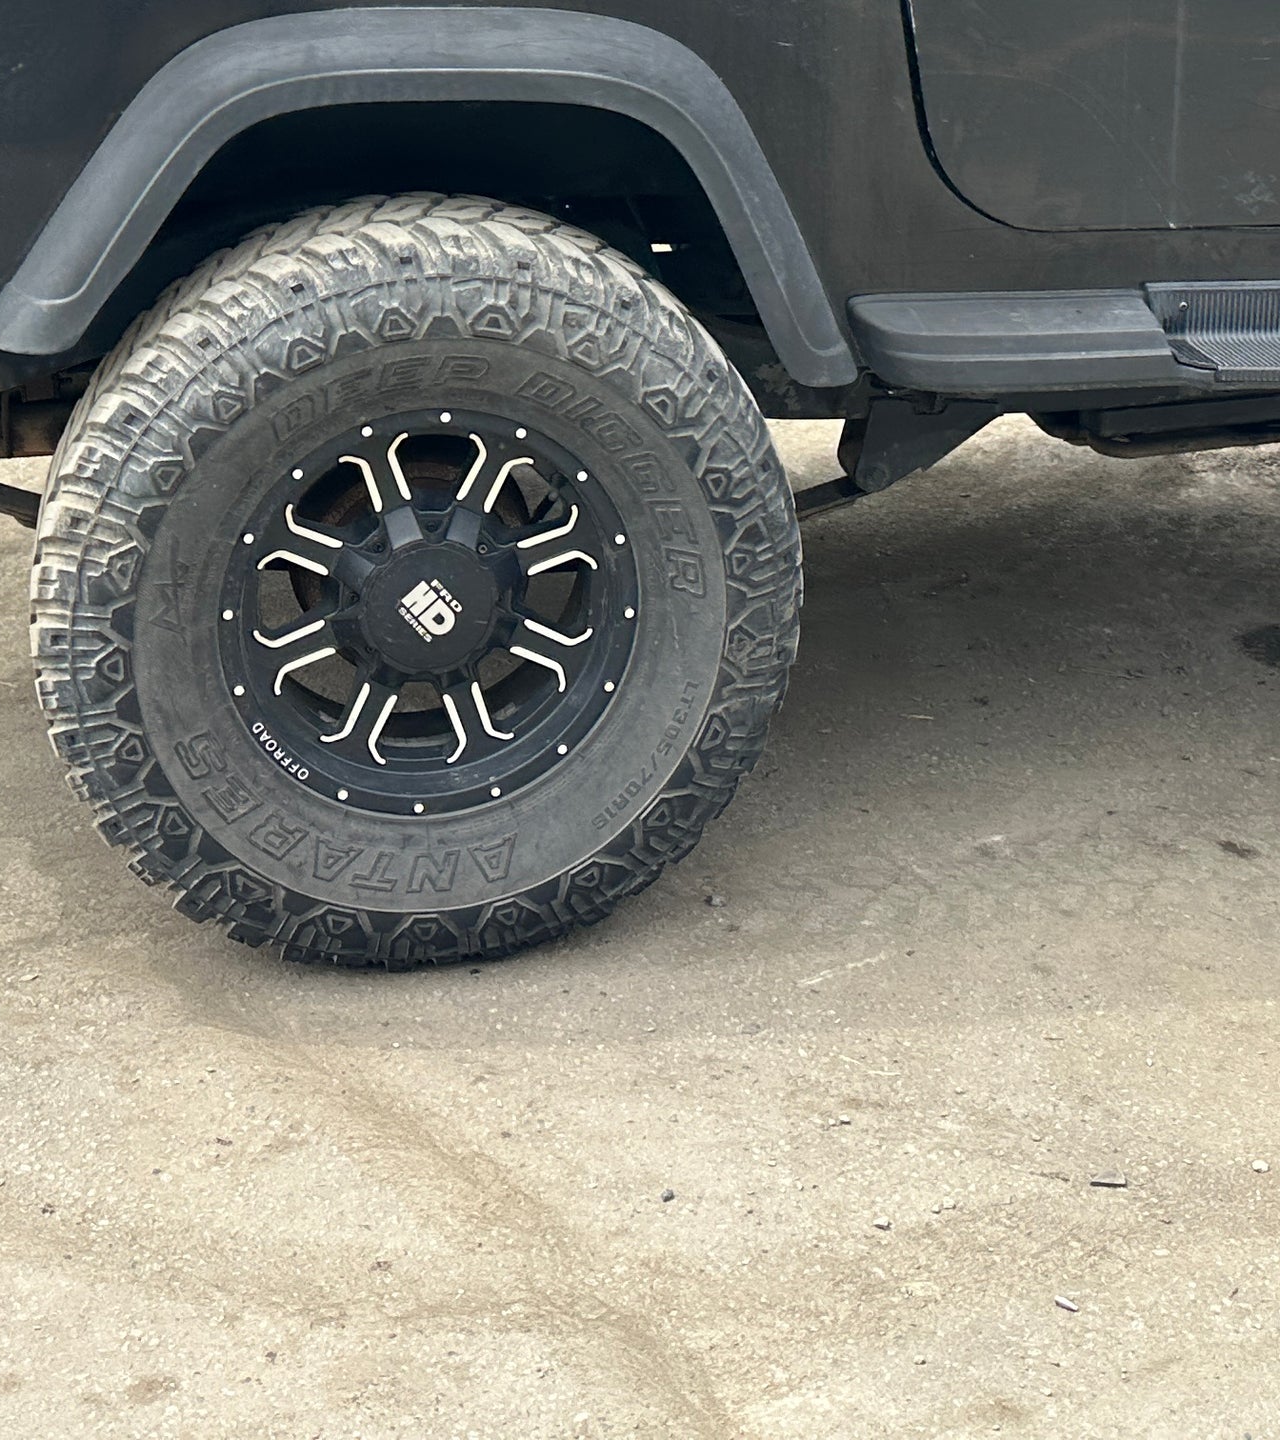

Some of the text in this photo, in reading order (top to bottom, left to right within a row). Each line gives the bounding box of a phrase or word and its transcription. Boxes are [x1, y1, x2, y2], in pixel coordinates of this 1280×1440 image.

[269, 354, 708, 600] DEEP DIGGER
[398, 606, 433, 643] SERIES
[401, 580, 456, 636] HD
[251, 721, 311, 781] OFFROAD
[174, 731, 518, 893] ANTARES
